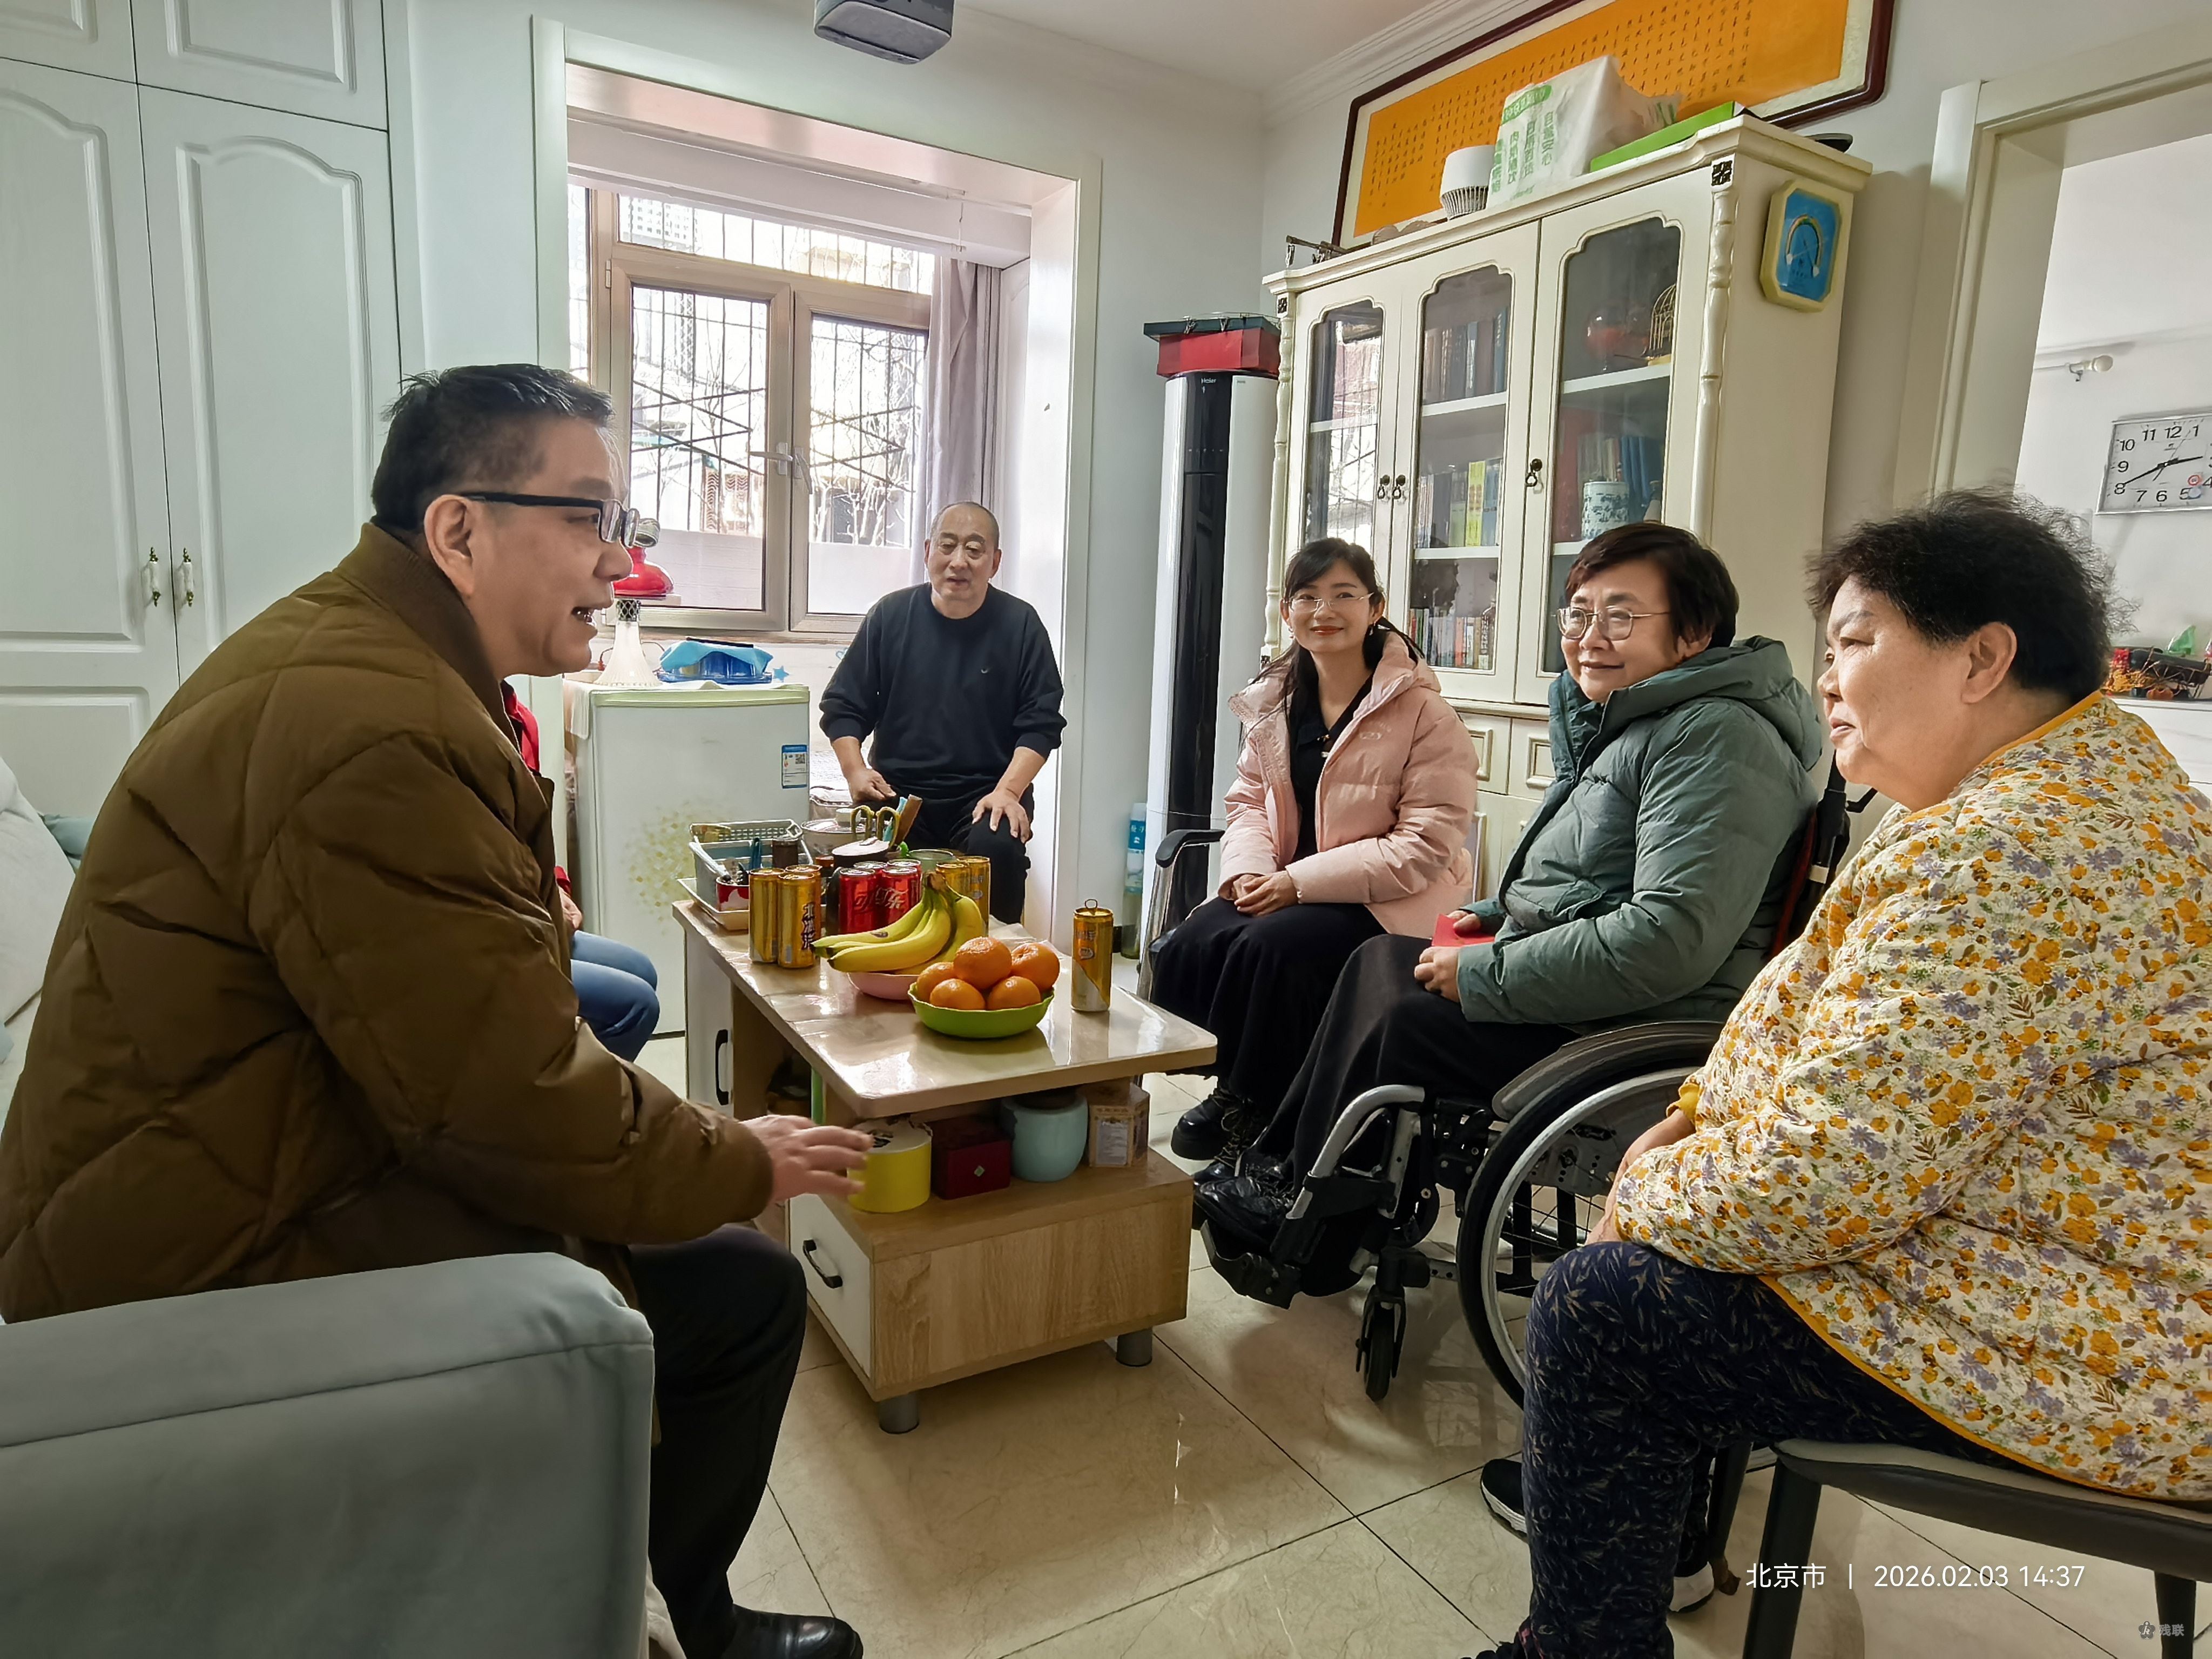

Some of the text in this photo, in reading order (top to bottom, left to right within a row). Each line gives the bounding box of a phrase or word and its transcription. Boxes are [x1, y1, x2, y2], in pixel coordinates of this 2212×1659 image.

[2142, 429, 2156, 441] 11
[2164, 426, 2182, 439] 12
[2193, 424, 2199, 437] 1
[2120, 439, 2135, 451] 10
[2117, 461, 2129, 473] 9
[2114, 482, 2126, 495] 8
[2136, 490, 2147, 502] 7
[2156, 490, 2168, 502] 6
